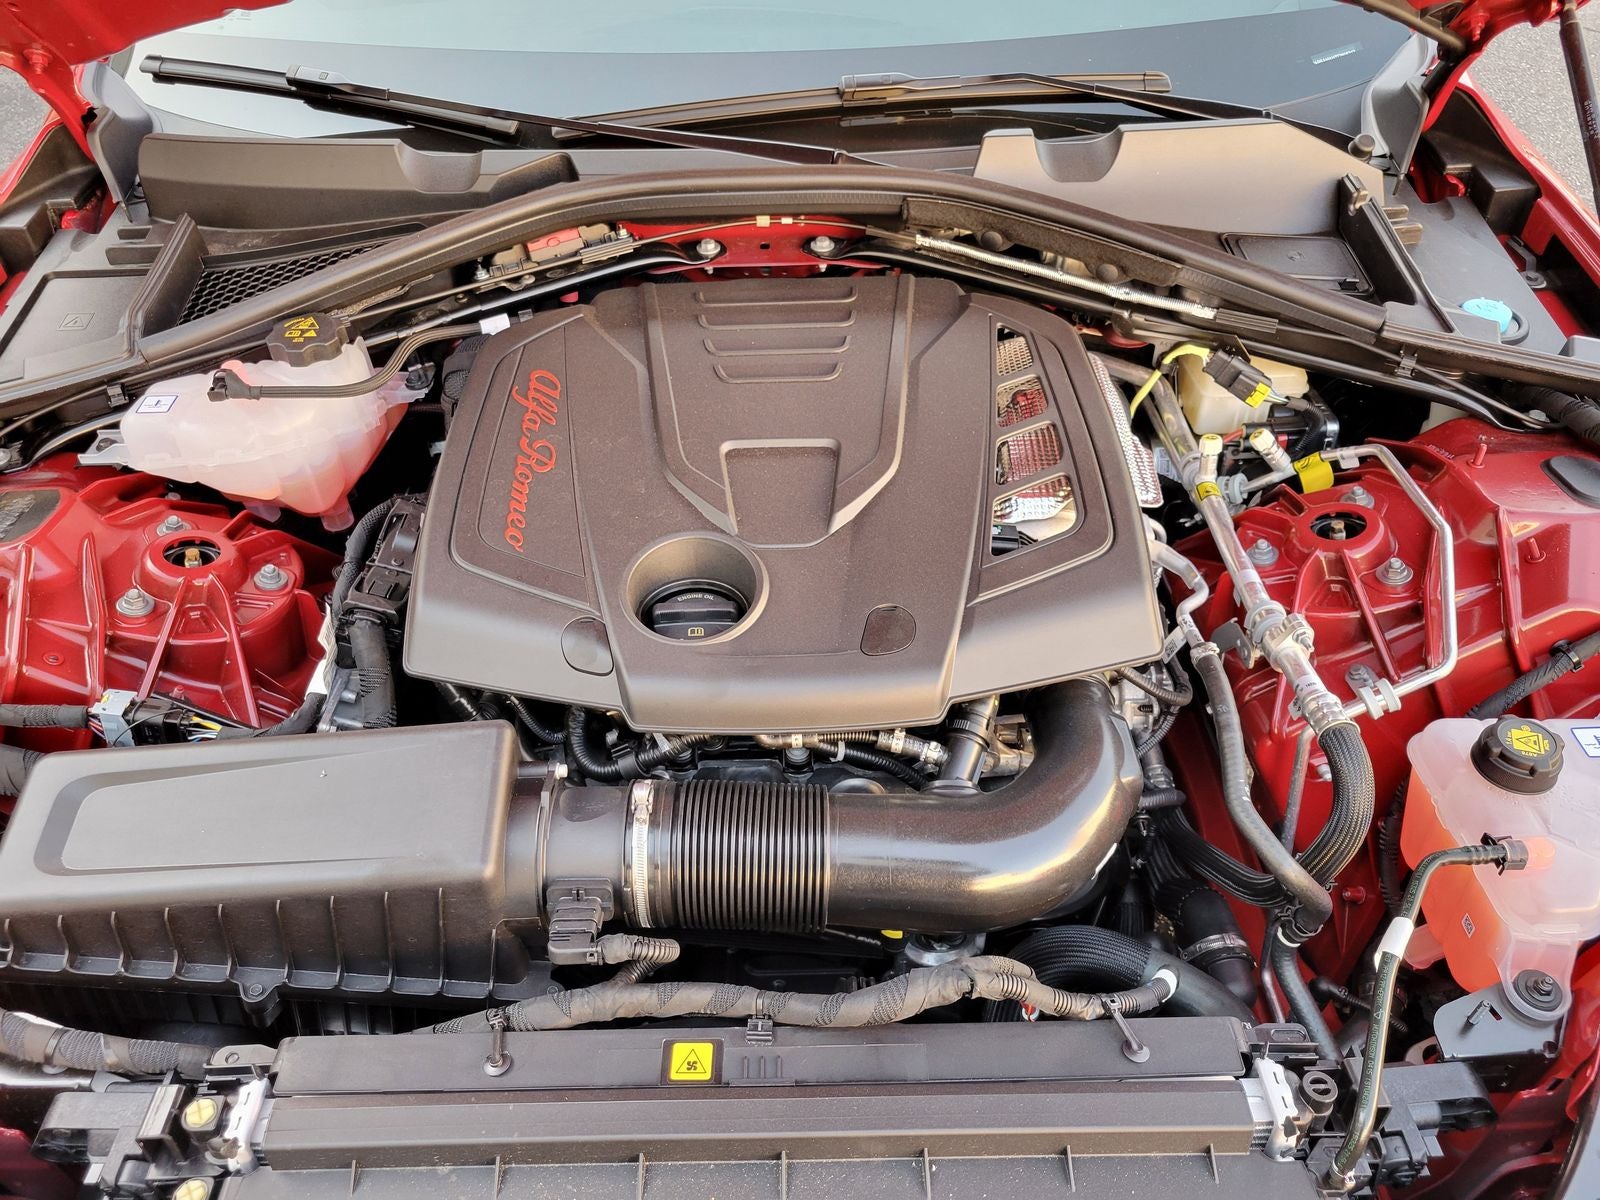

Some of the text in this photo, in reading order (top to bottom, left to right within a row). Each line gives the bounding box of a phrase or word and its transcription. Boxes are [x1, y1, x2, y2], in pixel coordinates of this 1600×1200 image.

[504, 369, 561, 553] Alfa Romeo
[677, 593, 703, 602] ENGINE
